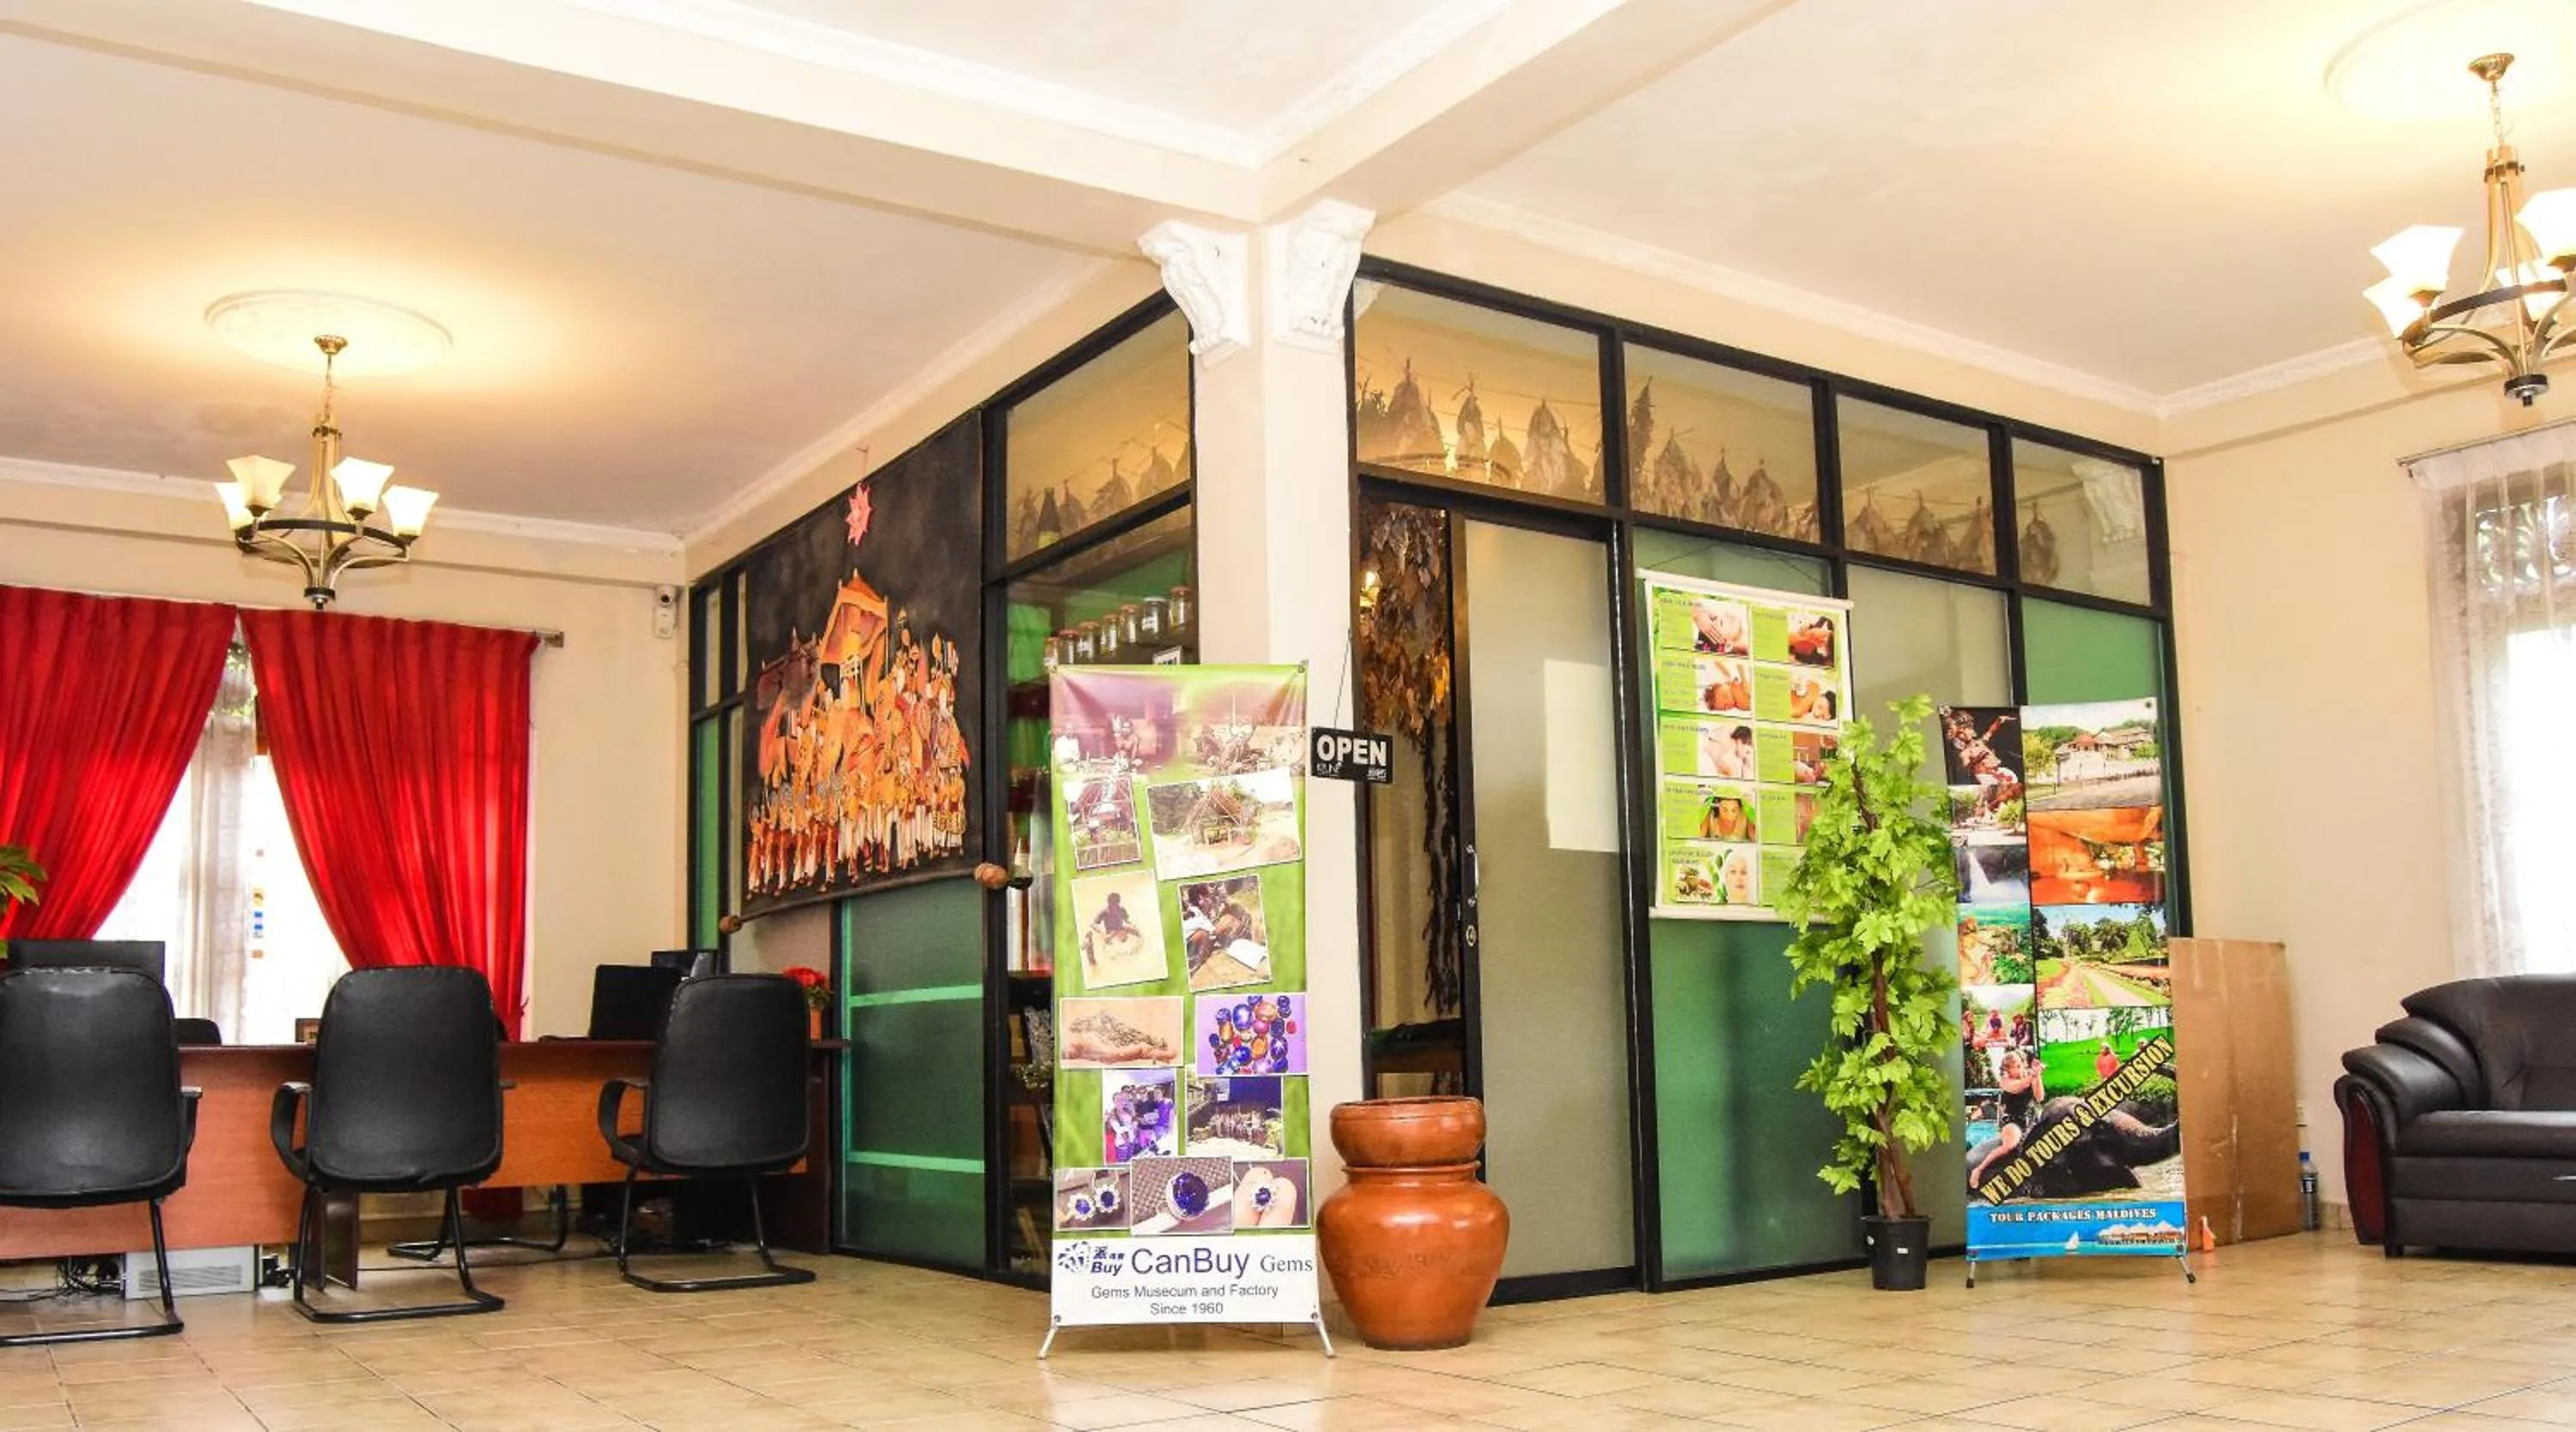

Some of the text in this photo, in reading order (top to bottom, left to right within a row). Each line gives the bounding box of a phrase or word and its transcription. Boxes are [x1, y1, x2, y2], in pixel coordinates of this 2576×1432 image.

[1316, 734, 1387, 766] OPEN
[1979, 1036, 2175, 1205] WE DO TOURS & EXCURSION
[1990, 1208, 2157, 1223] TOUR PACKAGES MALDIVES
[1091, 1261, 1122, 1277] Buy
[1131, 1247, 1250, 1279] CanBuy
[1260, 1254, 1313, 1273] Gems
[1091, 1285, 1130, 1299] Gems
[1202, 1284, 1225, 1297] and
[1230, 1283, 1279, 1299] Factory
[1150, 1302, 1224, 1315] Since 1960
